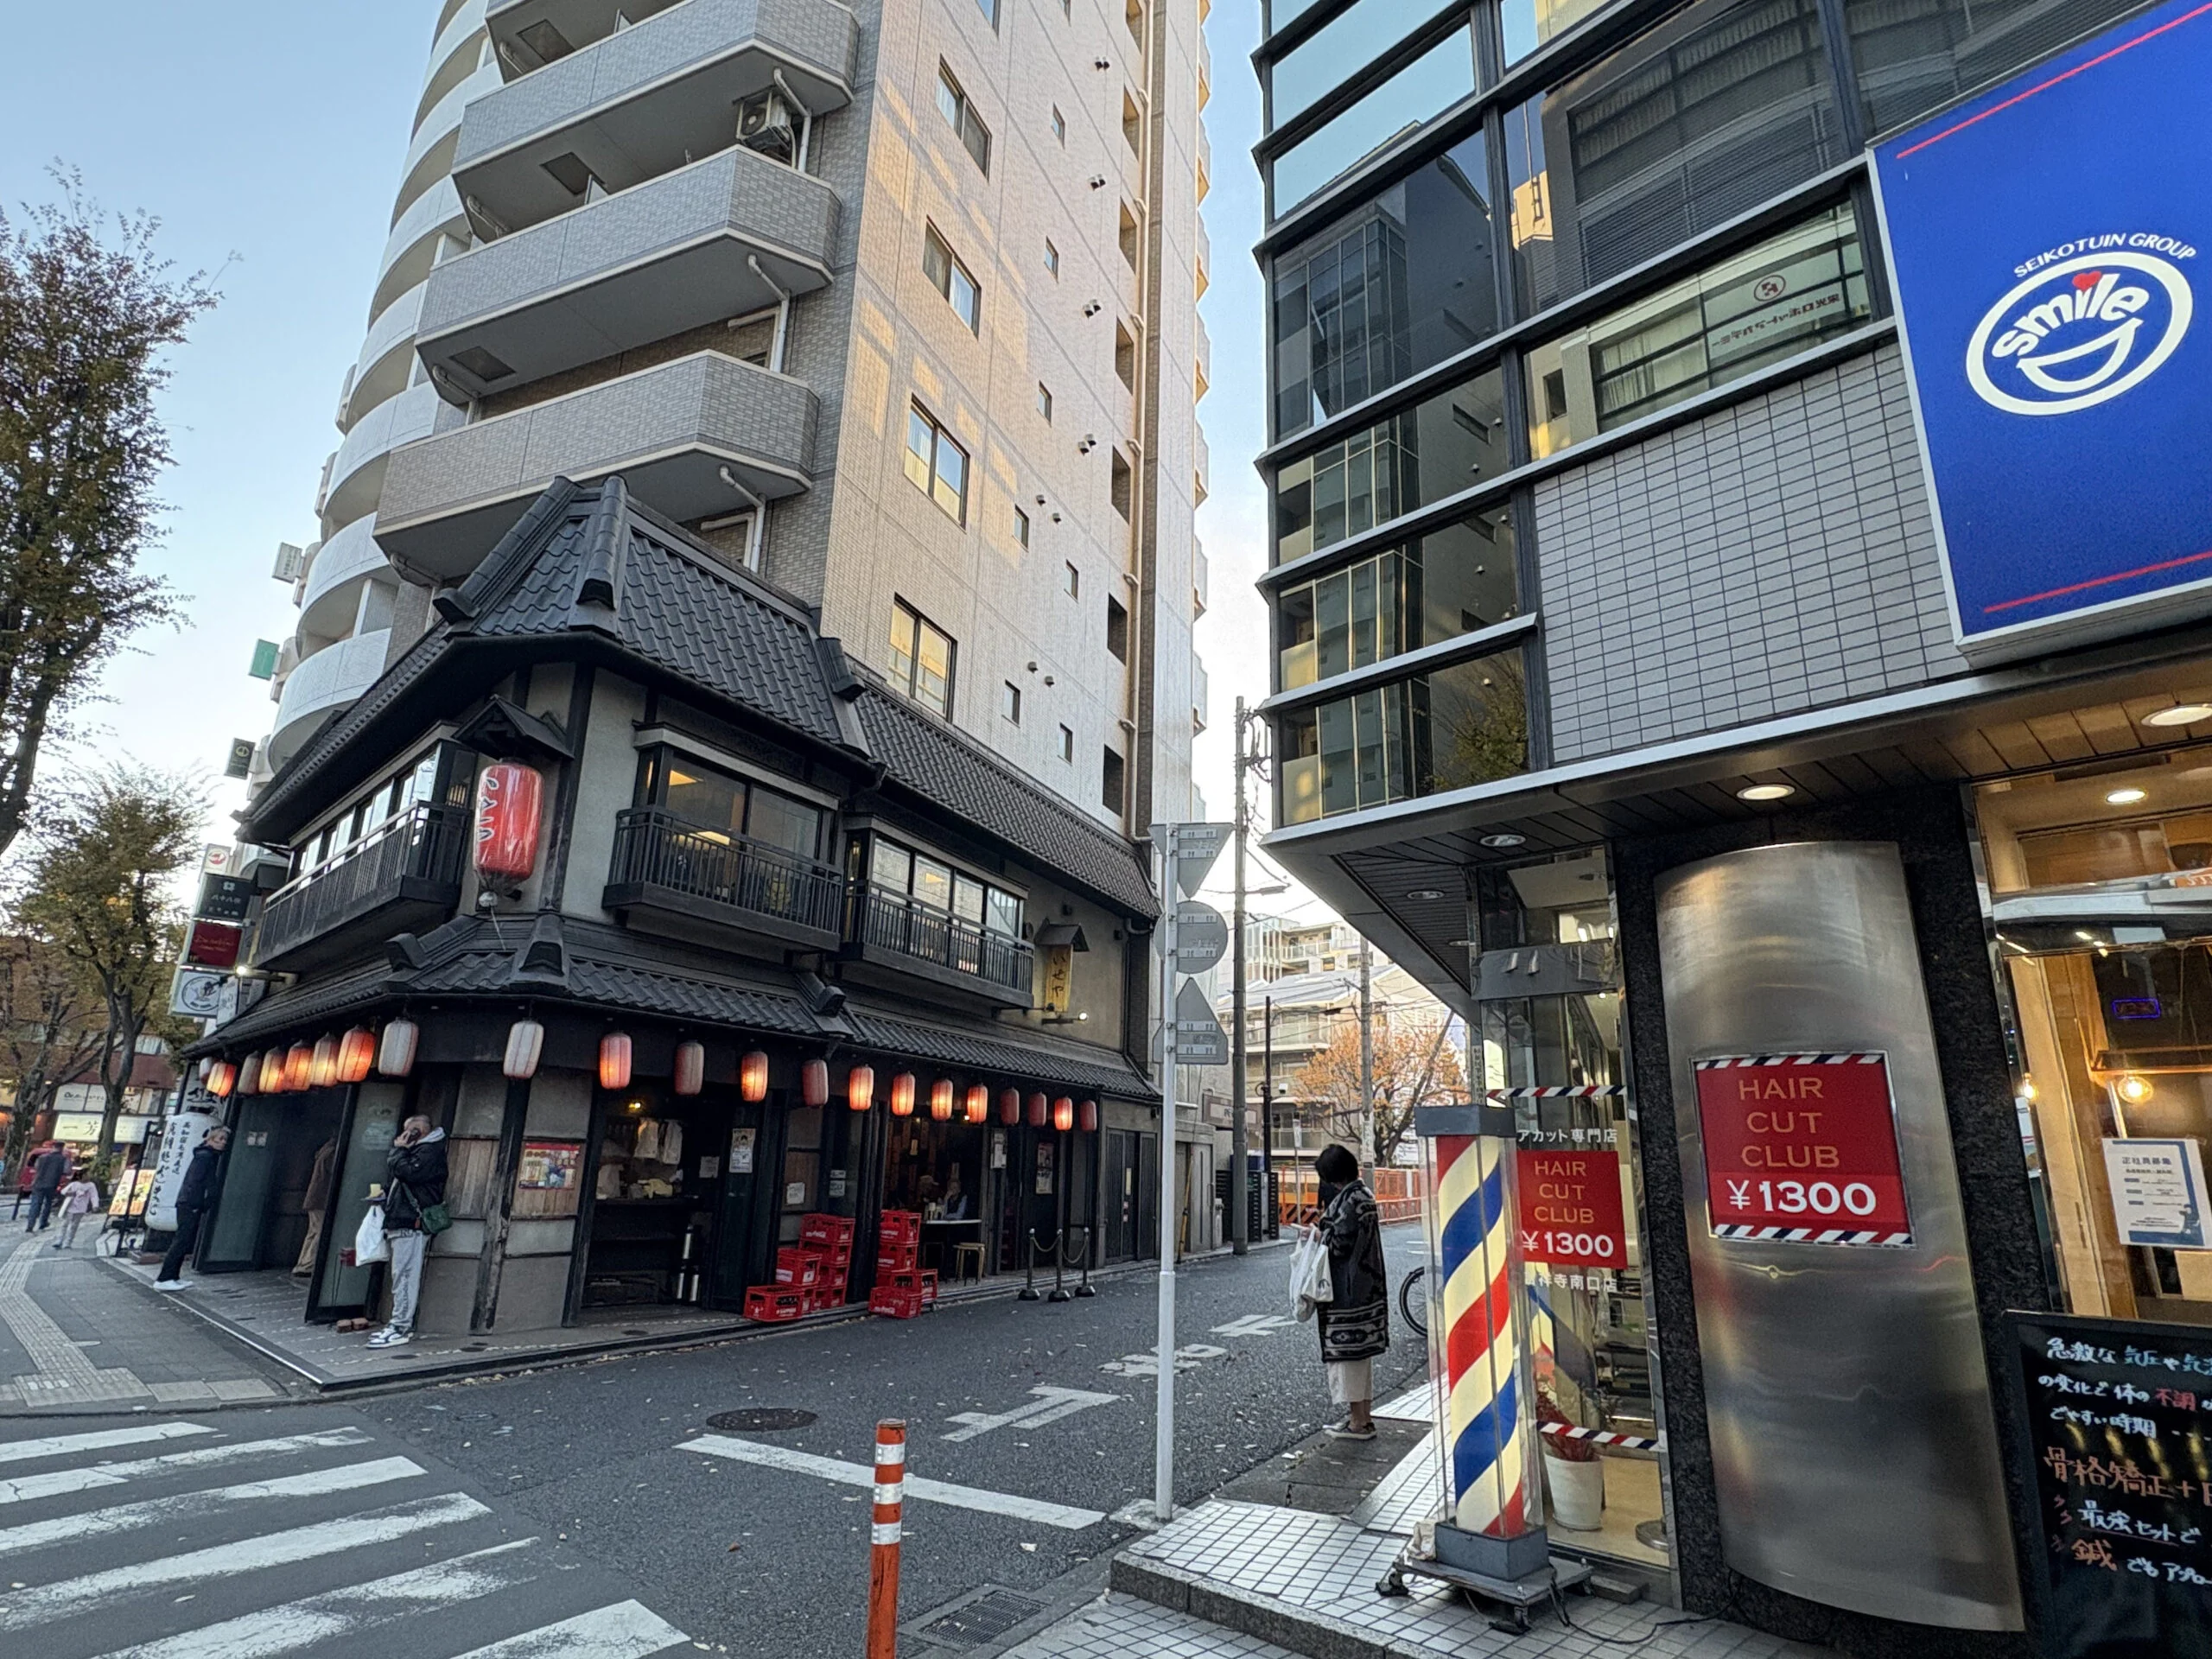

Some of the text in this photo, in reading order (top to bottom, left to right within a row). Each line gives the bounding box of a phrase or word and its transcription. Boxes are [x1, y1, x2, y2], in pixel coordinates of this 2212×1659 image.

[2013, 232, 2196, 277] SEIKOTUIN GROUP
[1052, 956, 1066, 998] いせや
[1738, 1077, 1825, 1101] HAIR
[1746, 1111, 1823, 1135] CUT
[1740, 1145, 1840, 1168] CLUB
[1534, 1160, 1587, 1177] HAIR
[1538, 1183, 1586, 1201] CUT
[1533, 1205, 1595, 1224] CLUB
